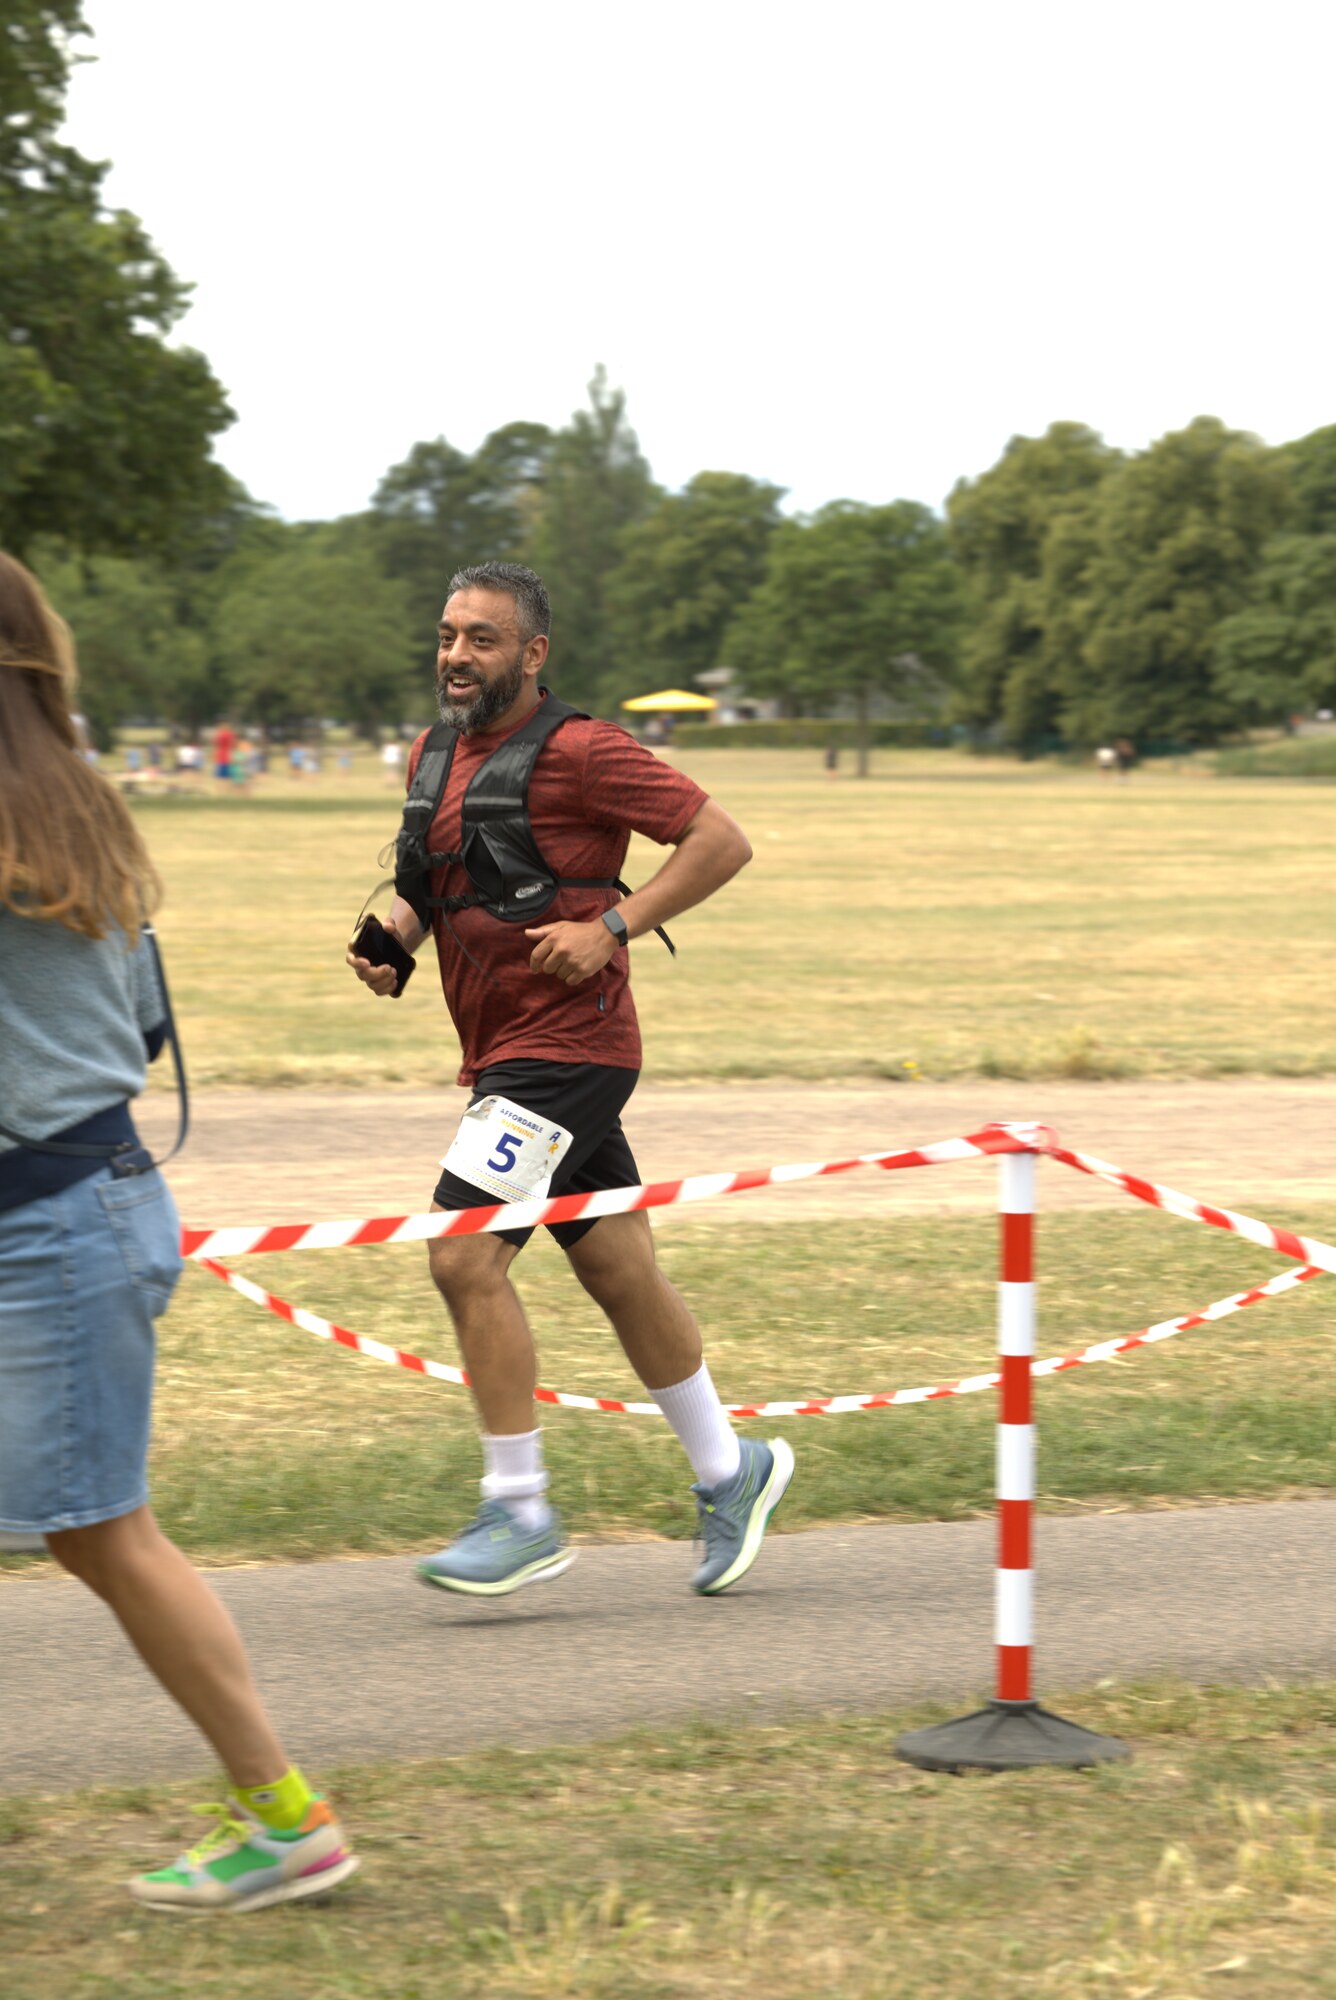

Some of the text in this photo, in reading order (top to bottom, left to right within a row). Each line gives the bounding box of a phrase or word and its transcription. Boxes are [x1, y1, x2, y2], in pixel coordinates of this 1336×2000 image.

[500, 1108, 544, 1134] AFFORDABLE
[549, 1131, 562, 1143] A
[487, 1132, 524, 1173] 5
